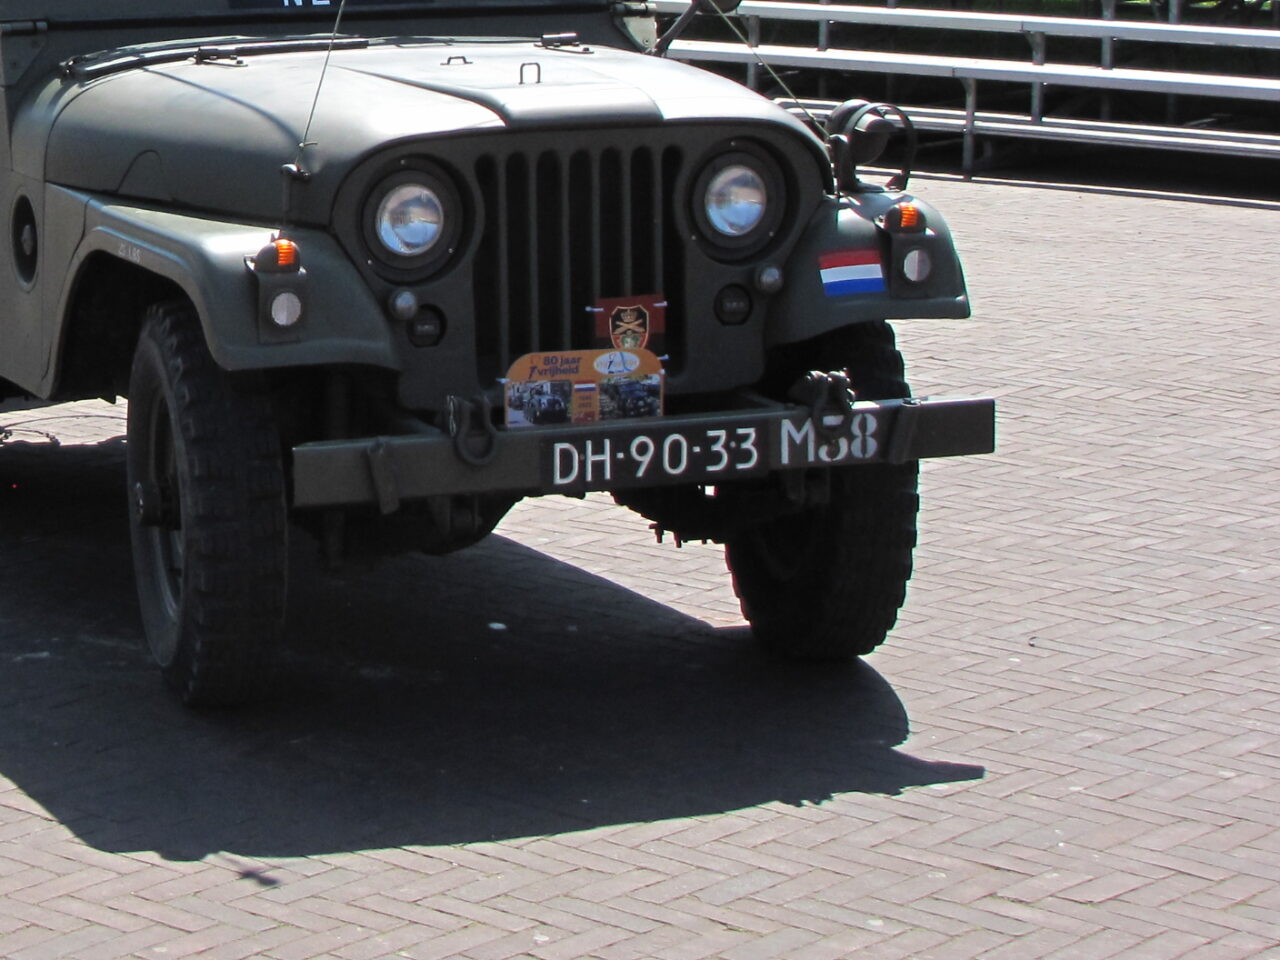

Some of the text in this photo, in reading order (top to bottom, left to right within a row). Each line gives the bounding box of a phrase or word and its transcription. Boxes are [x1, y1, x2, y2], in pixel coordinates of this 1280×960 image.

[543, 355, 582, 366] 80 jaar
[538, 365, 580, 378] vrijheid
[553, 427, 758, 485] DH-90-33
